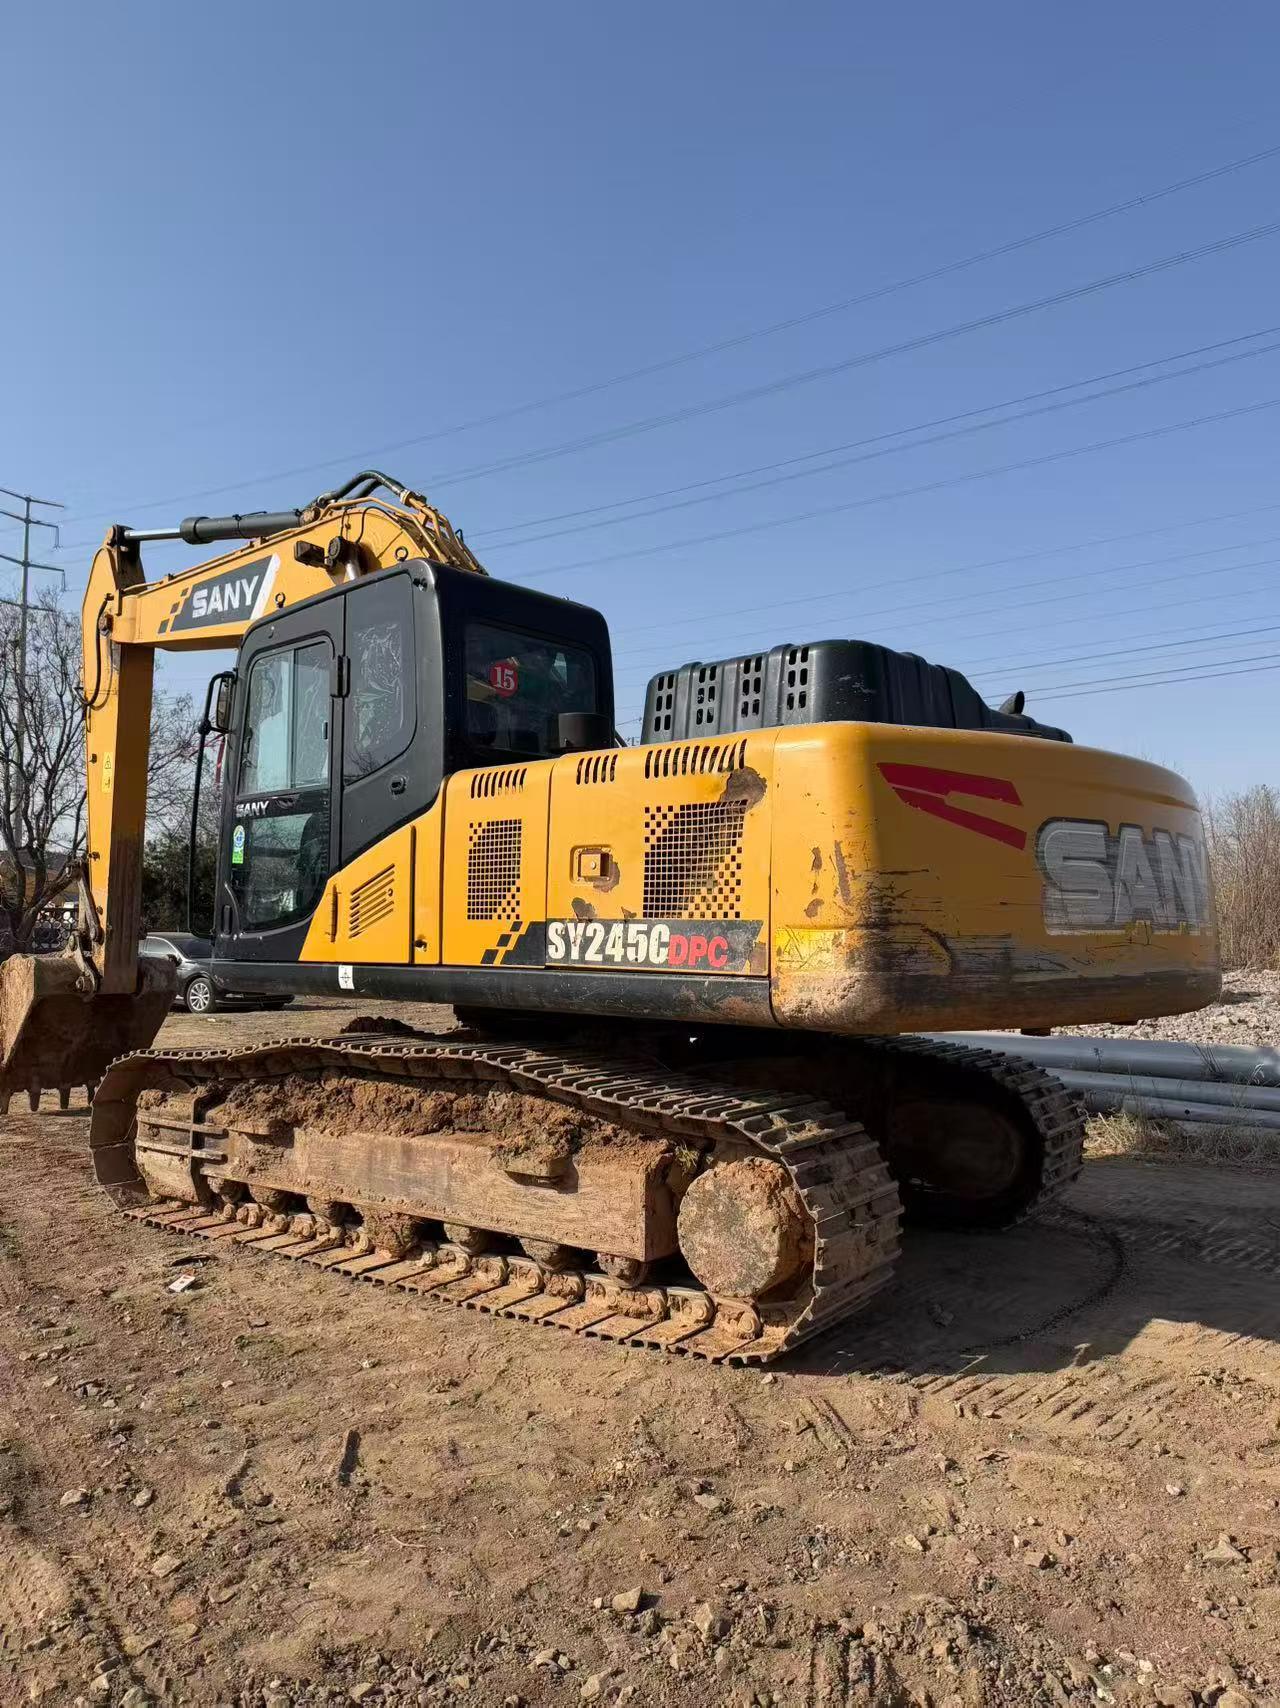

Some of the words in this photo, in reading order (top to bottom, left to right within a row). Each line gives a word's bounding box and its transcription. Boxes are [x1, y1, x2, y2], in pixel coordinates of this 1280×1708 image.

[192, 575, 259, 618] SANY
[494, 666, 515, 691] 15
[236, 800, 269, 818] SANY
[1036, 816, 1210, 935] SAN
